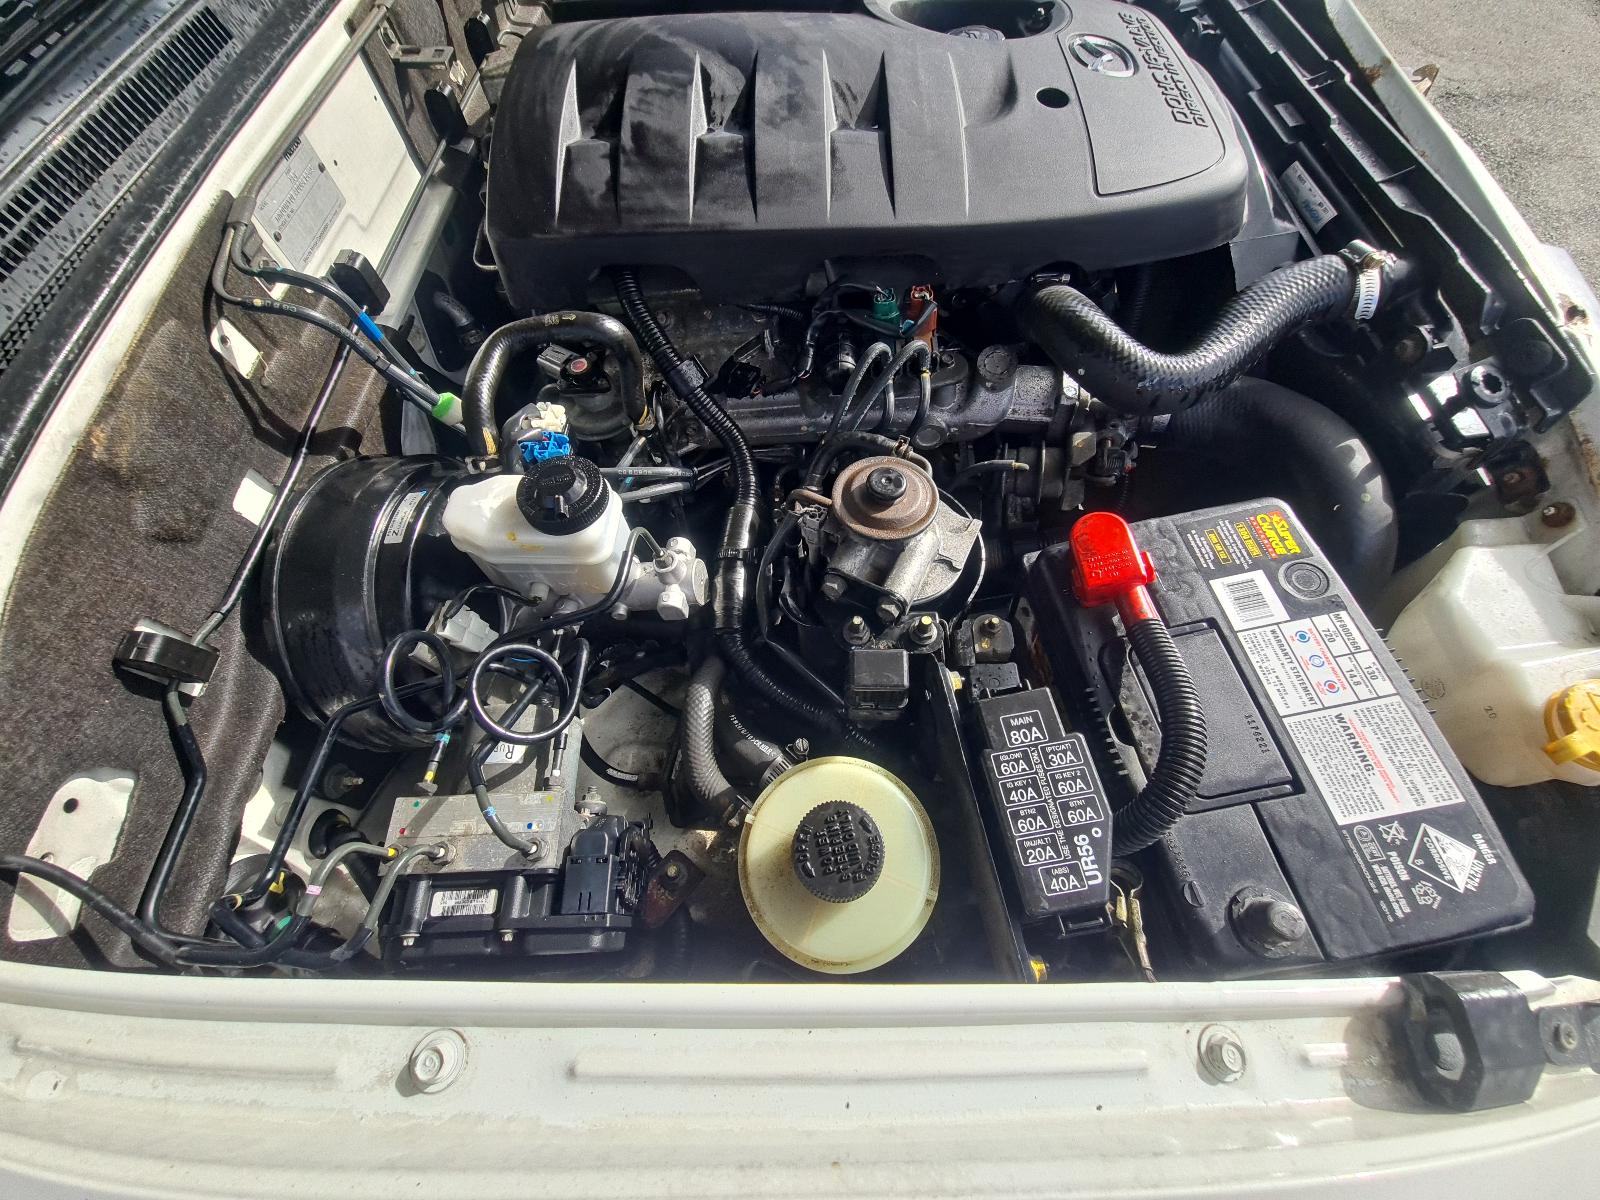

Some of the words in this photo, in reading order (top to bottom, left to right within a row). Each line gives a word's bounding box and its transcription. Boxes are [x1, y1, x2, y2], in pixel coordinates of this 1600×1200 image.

[1150, 72, 1192, 123] DOHC
[1169, 74, 1208, 126] DIRECT
[1254, 513, 1289, 554] CHARGE
[1272, 518, 1302, 553] SUPER
[1321, 628, 1336, 643] 720
[1332, 612, 1361, 651] MF80D26R
[1267, 628, 1295, 664] WARRANTY
[1288, 665, 1318, 706] STATEMENT
[1363, 665, 1378, 680] 130
[1344, 668, 1362, 686] 14.8
[1010, 716, 1032, 726] MAIN
[1010, 727, 1044, 745] 80A
[1333, 712, 1378, 776] WARNING:
[1030, 746, 1041, 763] ONLY
[1046, 744, 1072, 754] (PTC/AT)
[1000, 761, 1029, 774] 60A
[1048, 752, 1077, 766] 30A
[1038, 764, 1048, 786] FUSES
[1062, 770, 1075, 778] KEY
[1007, 780, 1013, 788] IG
[1058, 780, 1087, 794] 60A
[1009, 788, 1038, 803] 40A
[1044, 786, 1063, 828] DESIGNATED
[1067, 808, 1097, 823] 60A
[835, 807, 856, 841] ONLY
[1017, 816, 1047, 832] 60A
[1059, 830, 1067, 844] THE
[812, 829, 837, 876] POWER
[823, 814, 853, 882] STEERING
[1026, 848, 1056, 863] 20A
[1062, 845, 1072, 860] USE
[1471, 832, 1497, 865] DANGER
[844, 843, 867, 883] FLUID
[1074, 834, 1103, 885] UR56
[1386, 850, 1410, 881] POISON
[1413, 858, 1424, 866] 8
[1422, 836, 1452, 881] CORROSIVE
[1051, 866, 1069, 875] (ABS)
[1050, 875, 1080, 891] 40A
